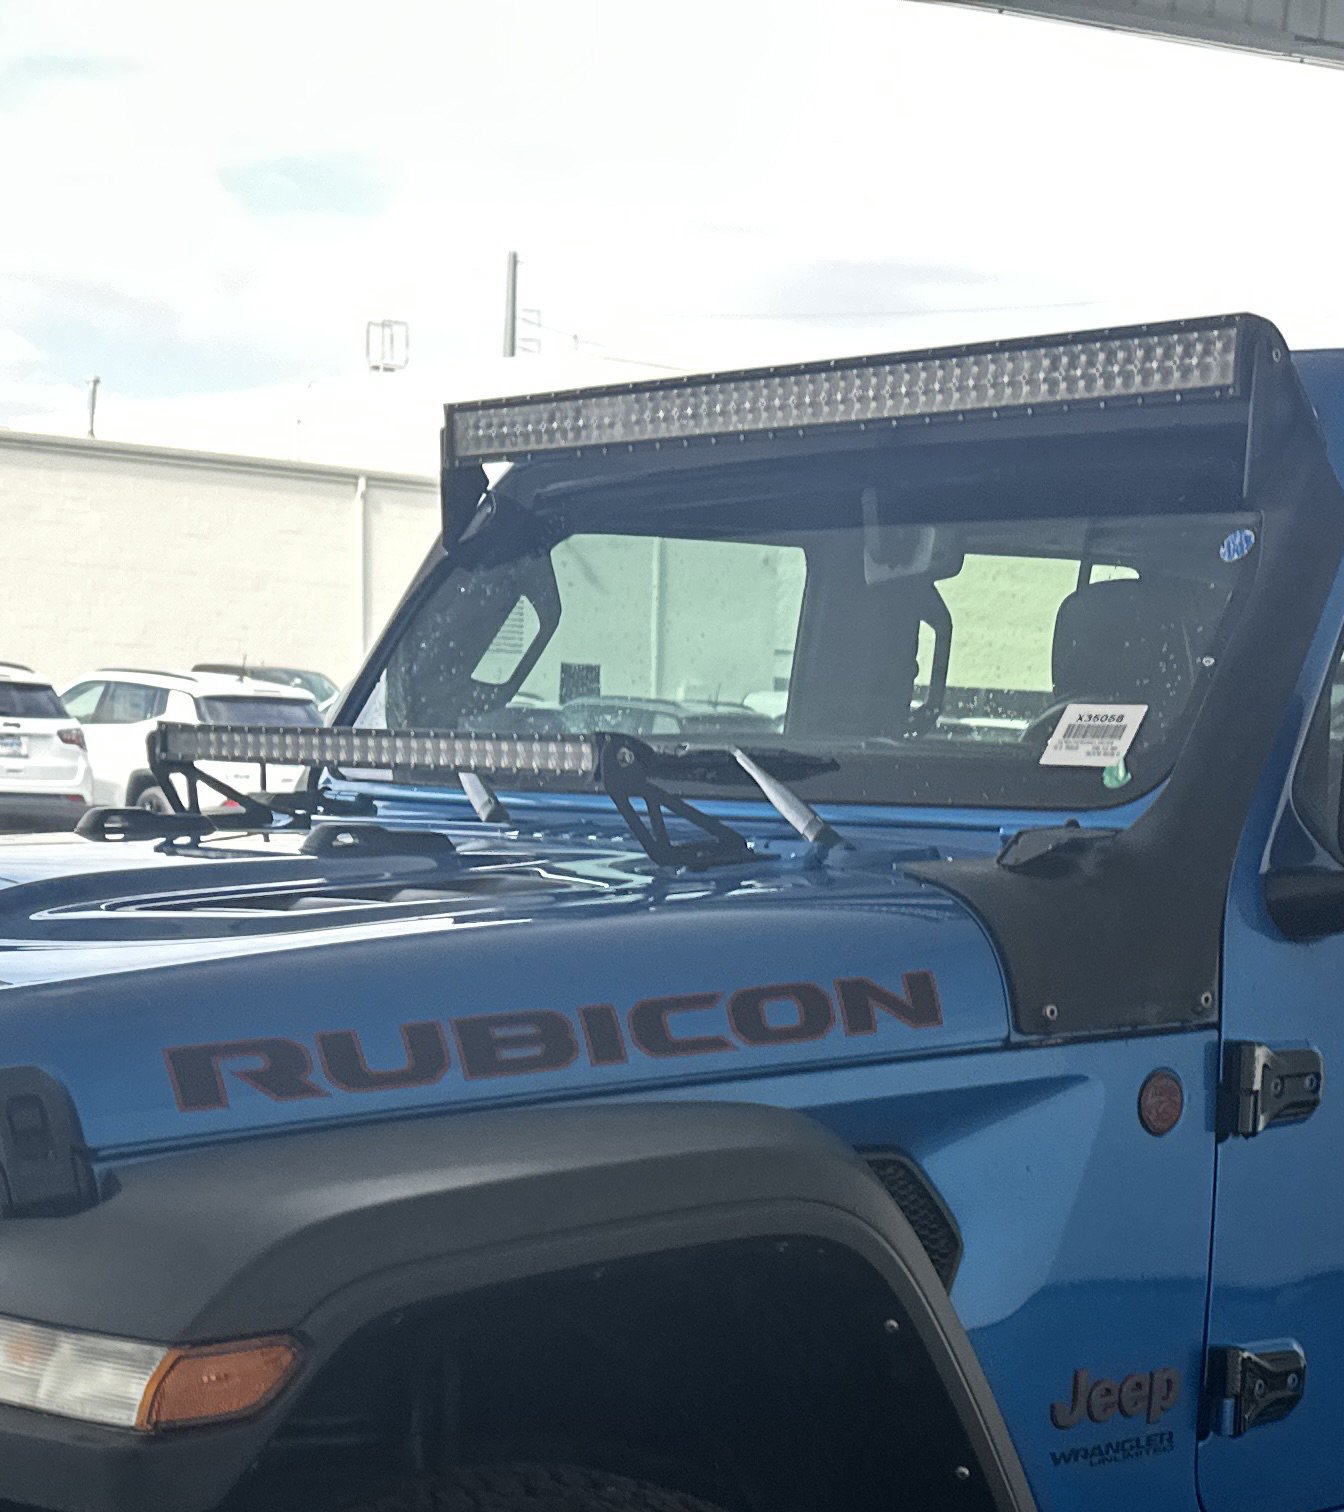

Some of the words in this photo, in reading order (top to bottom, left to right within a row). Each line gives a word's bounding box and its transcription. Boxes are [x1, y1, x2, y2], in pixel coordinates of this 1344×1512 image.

[162, 969, 943, 1113] RUBICON
[1050, 1367, 1181, 1431] Jeep
[1049, 1430, 1175, 1466] WRANGLER
